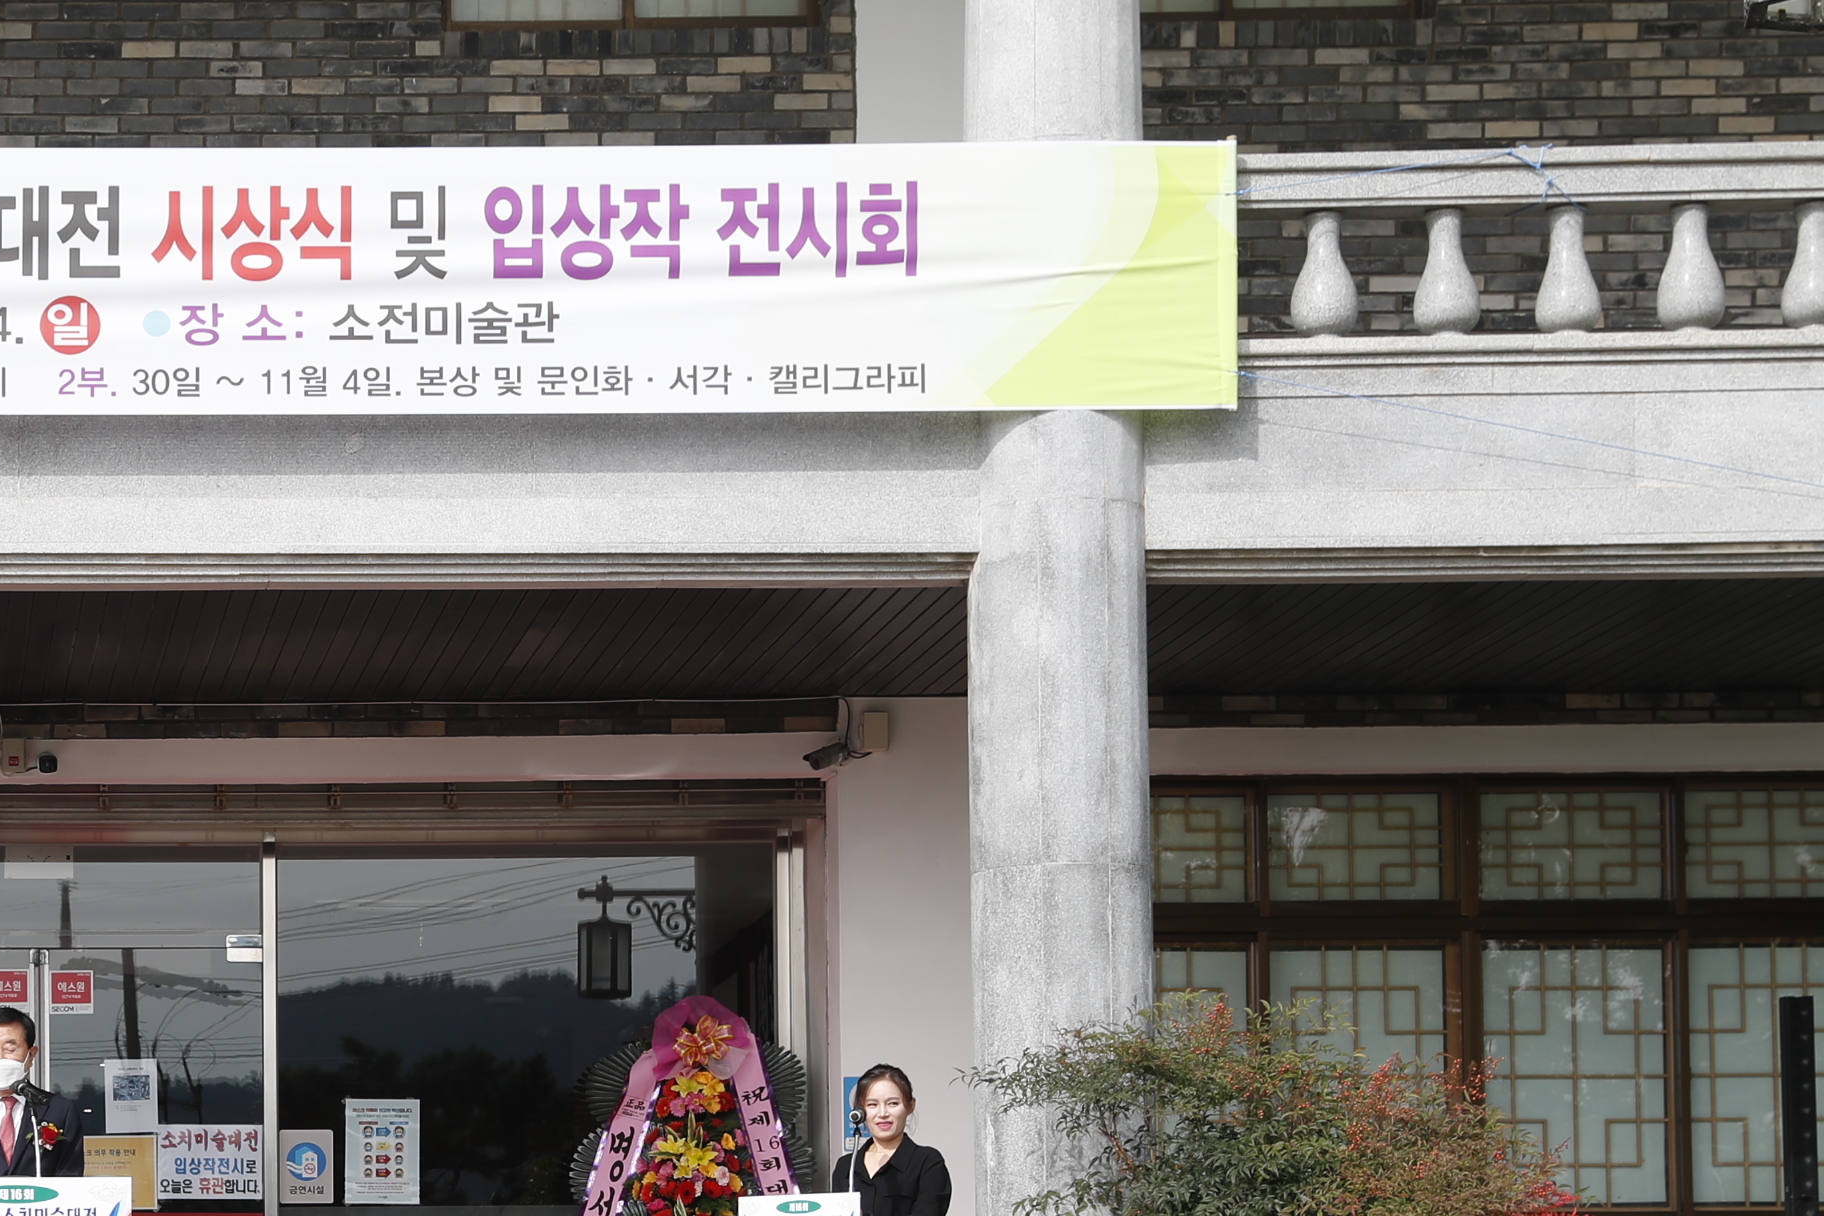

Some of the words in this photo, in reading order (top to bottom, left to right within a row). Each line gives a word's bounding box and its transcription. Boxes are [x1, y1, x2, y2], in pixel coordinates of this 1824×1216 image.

[153, 187, 352, 282] 시상식
[389, 185, 449, 281] 및
[485, 185, 690, 281] 입상작
[718, 182, 919, 278] 전시회
[47, 301, 92, 347] 일
[180, 303, 224, 346] 장
[330, 303, 560, 345] 소전미술관
[58, 367, 117, 399] 2부.
[134, 368, 201, 398] 30일
[263, 367, 327, 397] 11월
[344, 367, 402, 397] 4일.
[418, 367, 481, 398] 본상
[496, 367, 522, 397] 및
[539, 367, 633, 397] 문인화
[671, 366, 733, 396] 서각
[771, 365, 926, 396] 캘리그라피
[57, 981, 85, 993] 에스원
[160, 1128, 259, 1152] 소치미술대전
[174, 1157, 257, 1175] 입상작전시로
[160, 1179, 193, 1194] 오늘은
[289, 1186, 325, 1195] 금연시설
